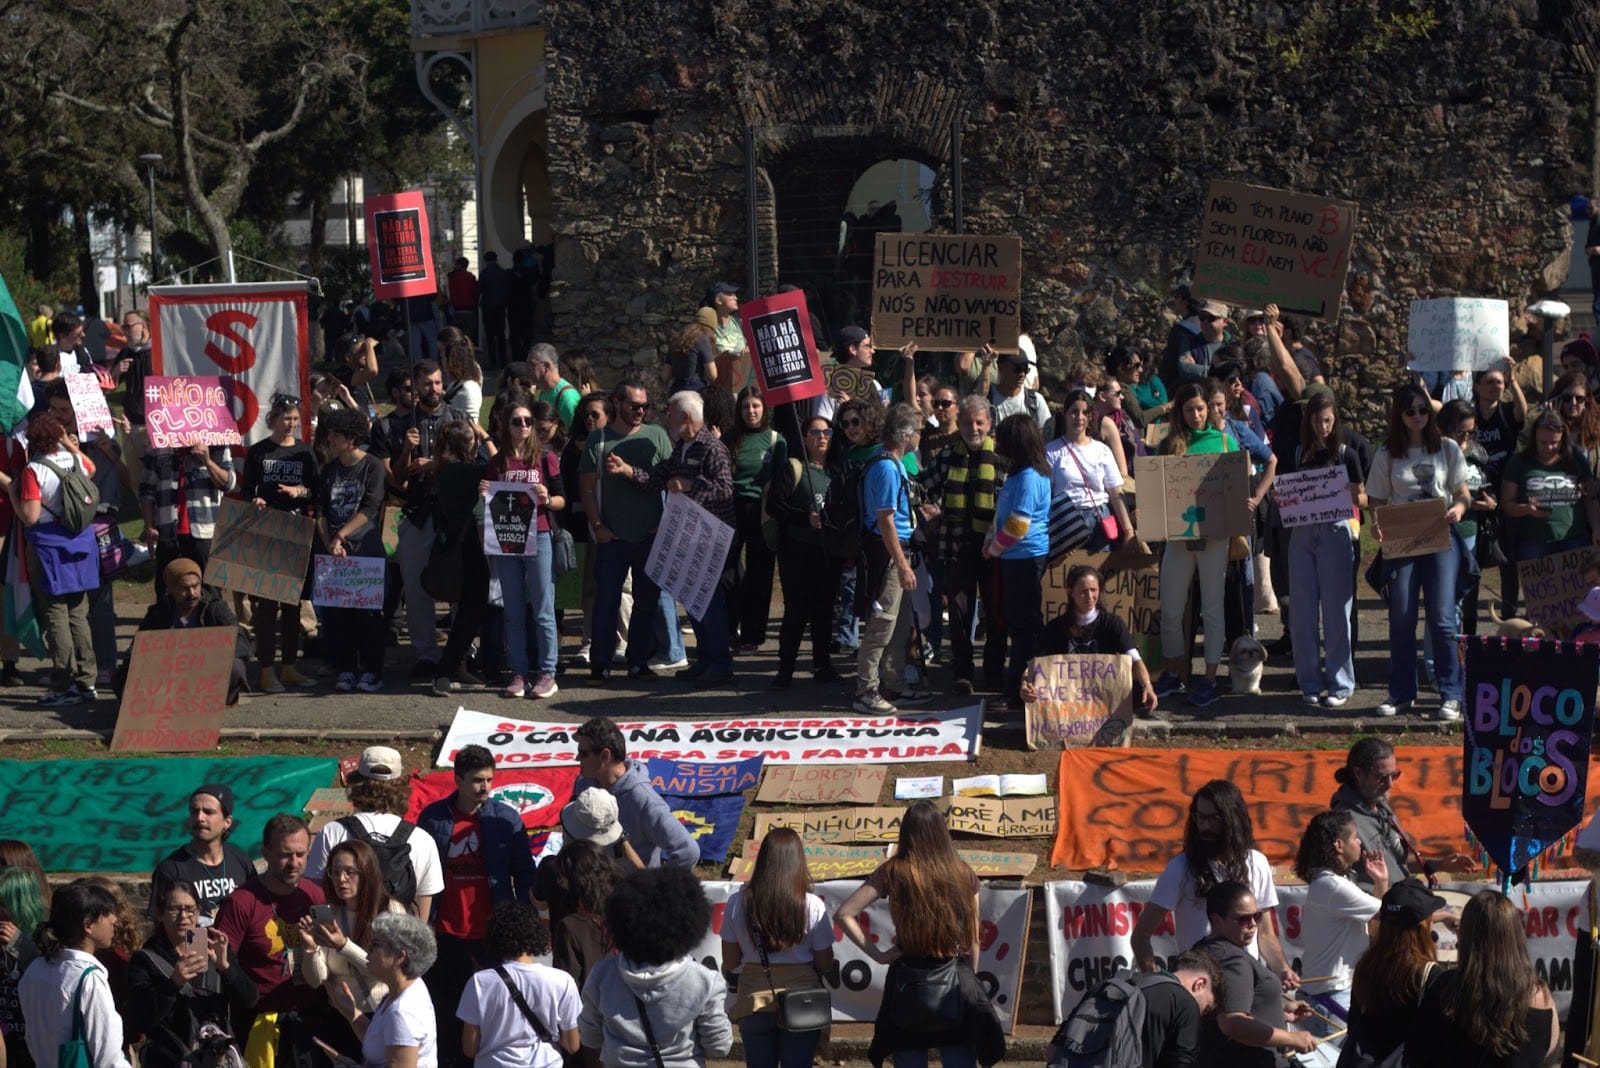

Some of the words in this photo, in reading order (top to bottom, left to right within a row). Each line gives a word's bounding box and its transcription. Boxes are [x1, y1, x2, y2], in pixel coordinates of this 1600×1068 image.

[1251, 201, 1273, 218] TEM
[1279, 205, 1313, 225] PLANO
[1317, 206, 1339, 235] B
[1209, 220, 1237, 237] SEM
[1242, 225, 1297, 248] FLORESTA
[881, 240, 998, 267] LICENCIAR
[1204, 240, 1235, 259] TEM
[1240, 242, 1266, 266] EU
[1266, 255, 1293, 272] NEM
[877, 269, 921, 288] PARA
[930, 270, 1009, 290] DESTRUIR
[878, 293, 915, 313] NÓS
[925, 294, 960, 314] NÃO
[964, 298, 1017, 316] VAMOS
[757, 324, 777, 341] NÃO
[779, 317, 796, 335] HÁ
[902, 317, 981, 337] PERMITIR
[760, 333, 800, 354] FUTURO
[764, 355, 776, 368] EM
[776, 350, 804, 366] TERRA
[145, 378, 202, 407] #NÃO
[206, 386, 227, 406] AO
[148, 408, 185, 432] PL
[183, 407, 218, 428] DA
[1476, 429, 1500, 441] ESPA
[262, 459, 304, 475] UFPR
[160, 654, 205, 675] SEM
[1032, 663, 1046, 681] A
[1053, 660, 1117, 680] TERRA
[131, 676, 190, 697] LUTA
[195, 674, 223, 693] DE
[1037, 686, 1068, 701] EVE
[1076, 687, 1104, 701] SER
[128, 695, 223, 717] CLASSES
[1474, 678, 1585, 736] BLOCO
[690, 719, 942, 730] TEMPERATURA
[487, 732, 514, 746] O
[629, 728, 681, 743] NA
[689, 726, 940, 743] AGRICULTURA
[1510, 726, 1545, 755] dos
[716, 749, 789, 760] SEM
[677, 764, 737, 777] SEM
[770, 766, 885, 782] FLORESTA
[650, 775, 756, 793] ANISTIA
[2, 786, 298, 819] FUTUO
[193, 877, 235, 899] VESPA
[1064, 901, 1176, 940] MINISTA
